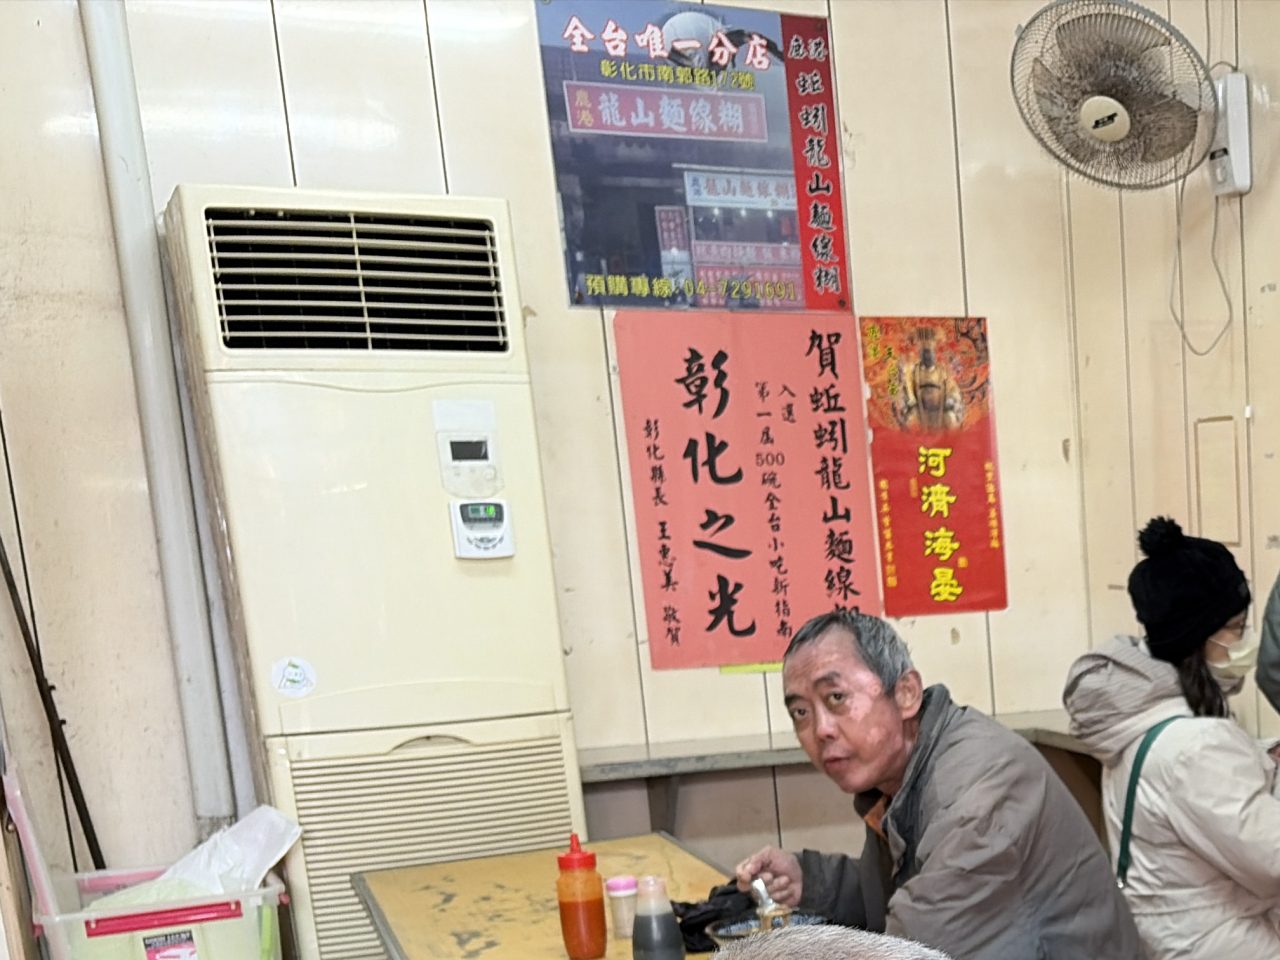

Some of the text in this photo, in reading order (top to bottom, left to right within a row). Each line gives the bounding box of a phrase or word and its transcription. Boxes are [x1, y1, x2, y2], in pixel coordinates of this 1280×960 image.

[563, 15, 772, 71] 全台唯一分店
[598, 91, 745, 134] 龍山麵線糊
[796, 70, 841, 295] 蚯蚓龍山麵線糊
[778, 383, 797, 424] 入選
[643, 419, 669, 507] 彰化縣長
[674, 348, 756, 637] 彰化之光
